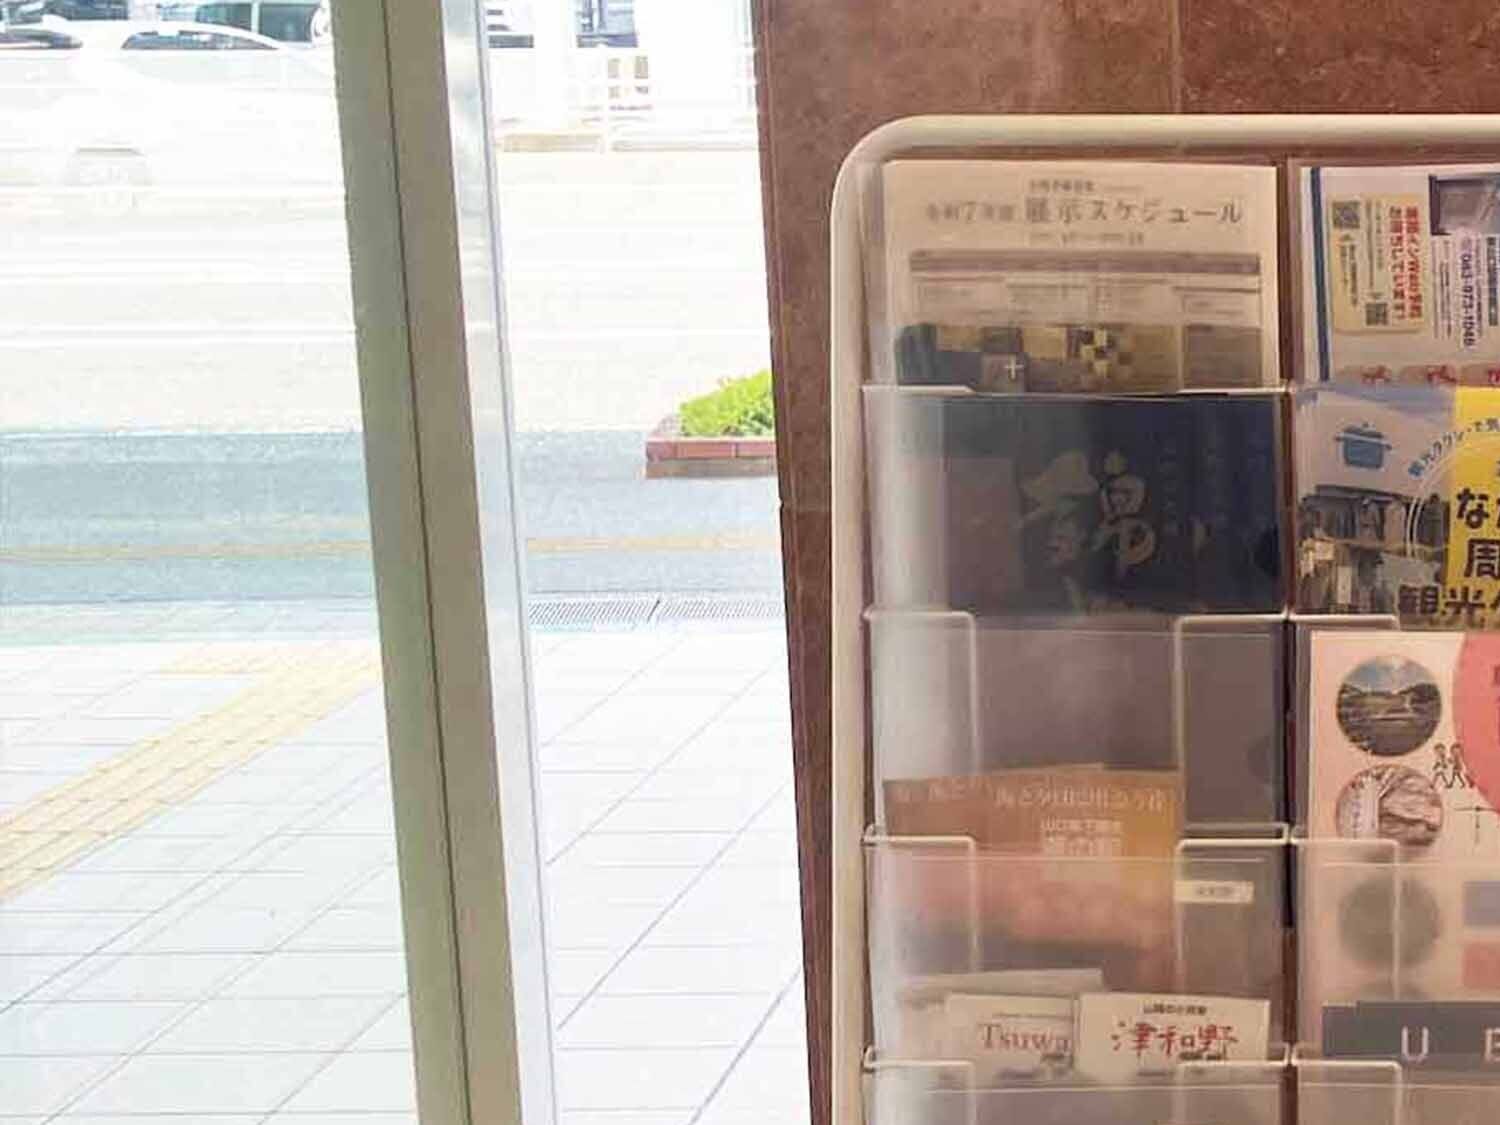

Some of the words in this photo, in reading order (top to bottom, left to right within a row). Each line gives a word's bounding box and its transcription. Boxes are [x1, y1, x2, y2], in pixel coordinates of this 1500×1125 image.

[1025, 198, 1242, 226] 展示スケジュール
[1110, 1021, 1239, 1061] 津和野
